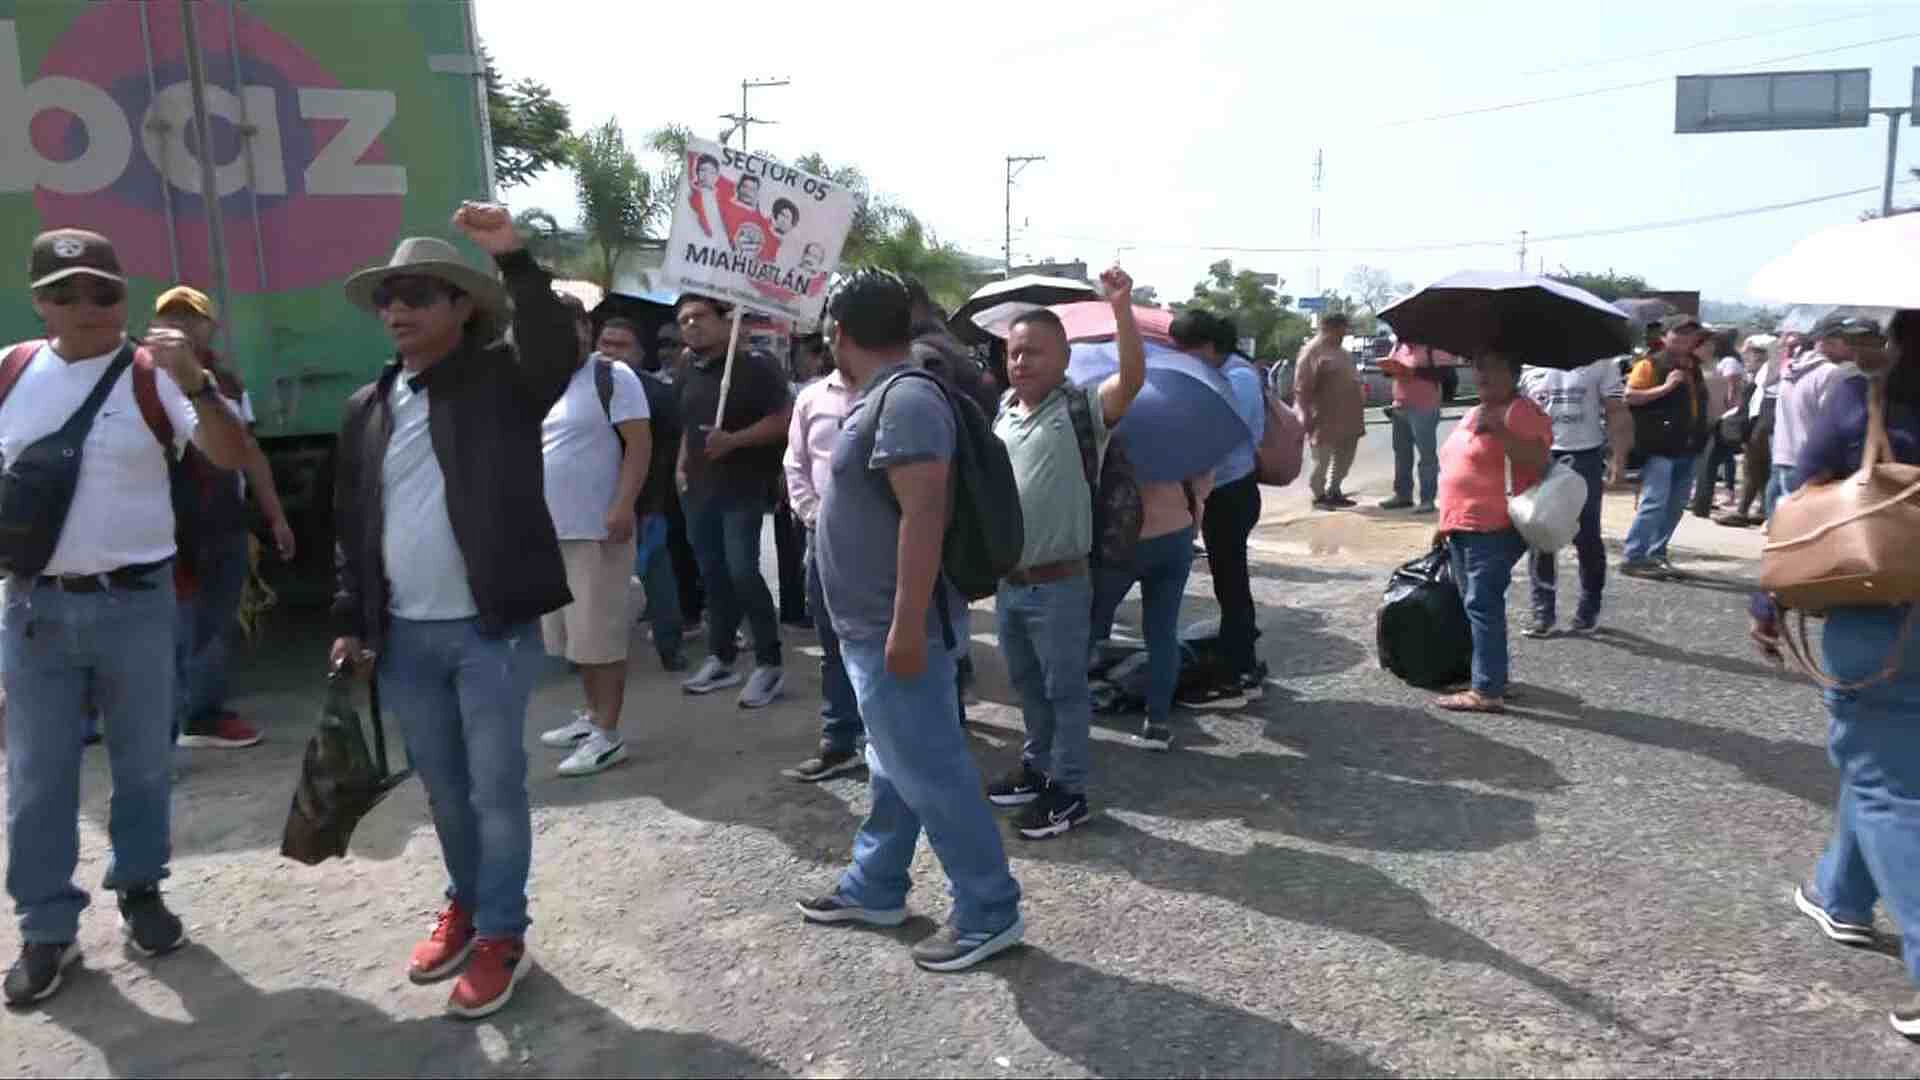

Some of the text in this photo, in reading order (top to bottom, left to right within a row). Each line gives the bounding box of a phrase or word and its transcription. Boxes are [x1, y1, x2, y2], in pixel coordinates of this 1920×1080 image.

[0, 19, 408, 195] baz
[721, 147, 831, 202] SECTOR 05
